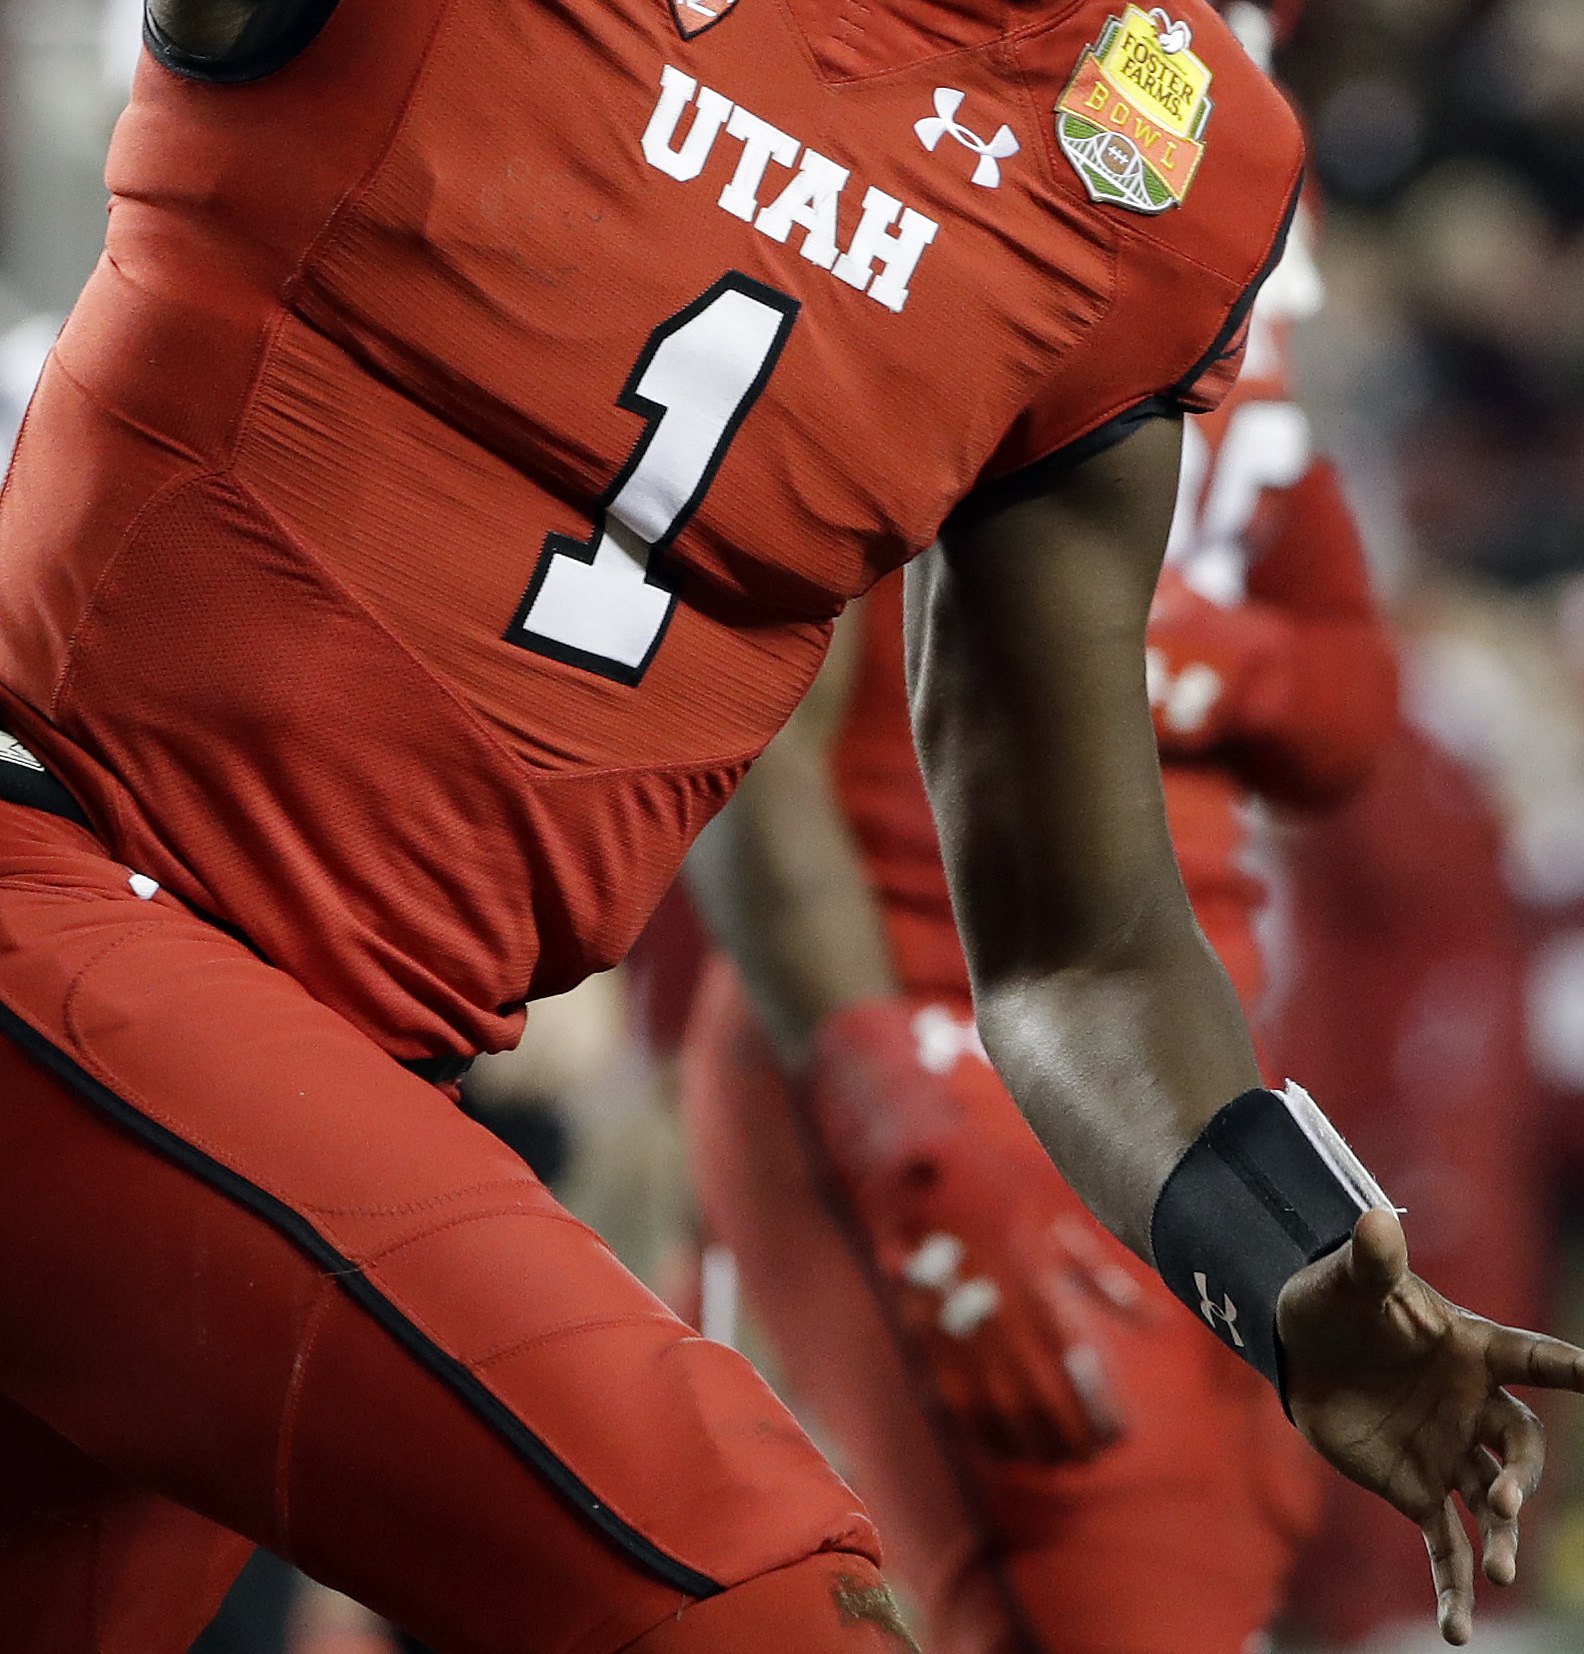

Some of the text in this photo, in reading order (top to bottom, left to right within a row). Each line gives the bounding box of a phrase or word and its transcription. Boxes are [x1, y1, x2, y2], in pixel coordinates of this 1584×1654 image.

[1083, 80, 1178, 171] BOWL
[1121, 33, 1194, 106] FOSTER
[640, 64, 939, 313] UTAH
[502, 269, 803, 688] 1
